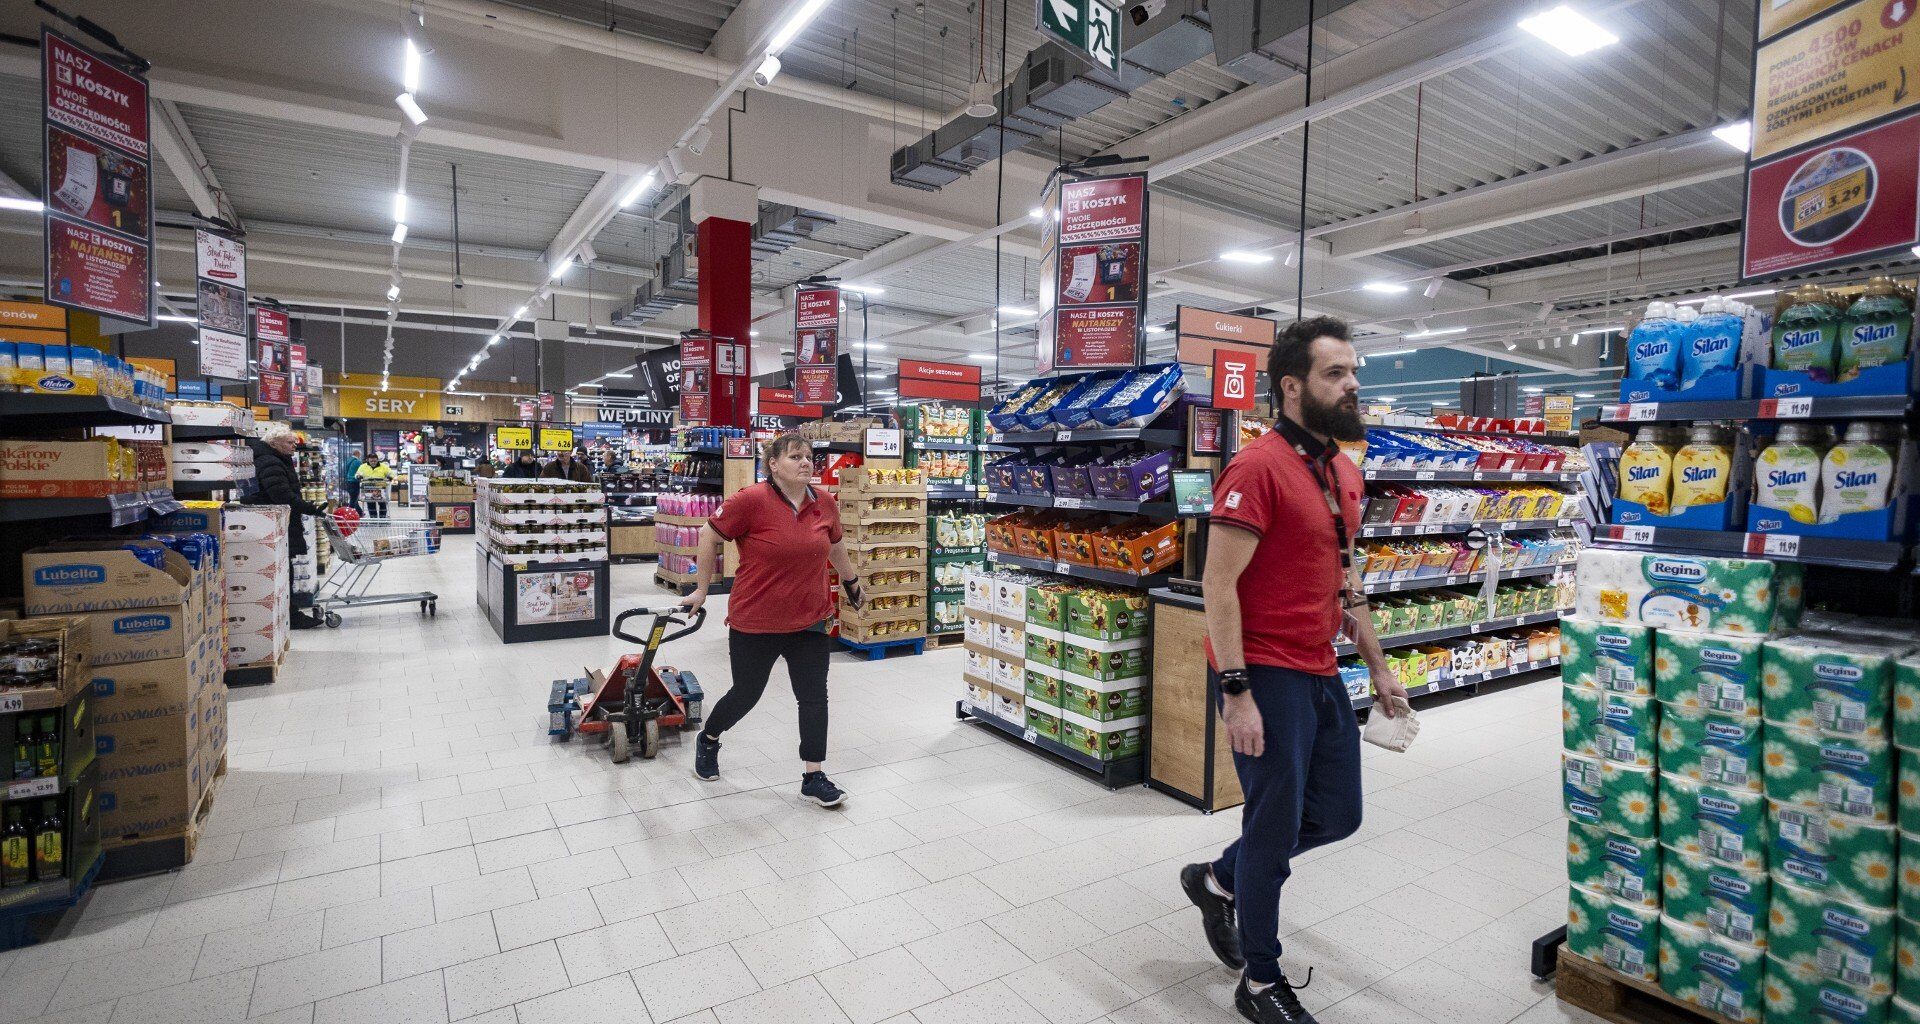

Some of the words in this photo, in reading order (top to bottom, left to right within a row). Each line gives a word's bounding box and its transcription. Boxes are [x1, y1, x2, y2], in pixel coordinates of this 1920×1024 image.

[1770, 52, 1805, 72] PONAD
[1808, 20, 1861, 52] 4500
[1842, 32, 1903, 66] CENACH
[54, 47, 91, 74] NASZ
[56, 86, 88, 105] TWOJE
[76, 74, 129, 107] KOSZYK
[1767, 70, 1846, 108] REGULARNYCH
[1766, 85, 1847, 120] OZNACZONYCH
[1815, 81, 1886, 114] ETYKIETAMI
[56, 97, 130, 133] OSZCZĘDNOŚCI!
[1068, 187, 1095, 199] NASZ
[1828, 186, 1860, 208] 3.29
[1082, 195, 1126, 210] KOSZYK
[1798, 200, 1825, 220] CENY
[113, 211, 121, 227] 1
[1067, 214, 1090, 224] TWOJE
[1067, 217, 1126, 231] OSZCZĘDNOŚCI!
[67, 228, 89, 240] NASZ
[102, 239, 133, 254] KOSZYK
[70, 240, 133, 265] NAJTAŃSZY
[1107, 286, 1115, 300] 1
[808, 300, 830, 308] KOSZYK
[1072, 318, 1123, 328] NAJTAŃSZY
[1215, 322, 1242, 333] Cukierki
[1782, 330, 1820, 350] Silan
[1852, 324, 1895, 346] Silan
[1636, 343, 1668, 360] Silan
[1692, 338, 1728, 356] Silan
[1630, 392, 1648, 401] Silan
[1775, 384, 1799, 396] Silan
[366, 399, 416, 413] SERY
[1791, 404, 1809, 414] 11.99
[599, 409, 672, 424] WĘDLINY
[1641, 409, 1656, 418] 11.99
[132, 425, 154, 434] 1.79
[1628, 466, 1659, 481] Silan
[1682, 467, 1716, 483] Silan
[1767, 470, 1806, 488] Silan
[1834, 471, 1876, 489] Silan
[1621, 512, 1640, 522] Silan
[1758, 521, 1780, 530] Silan
[1635, 532, 1649, 541] 11.99
[1780, 542, 1796, 553] 11.99
[41, 569, 98, 580] Lubella
[1655, 563, 1700, 575] Regina
[119, 618, 165, 629] Lubella
[1599, 635, 1627, 645] Regina
[1704, 650, 1737, 661] Regina
[1818, 665, 1857, 676] Regina
[4, 701, 21, 709] 4.99
[1709, 724, 1741, 735] Regina
[1825, 750, 1864, 760] Regina
[1572, 805, 1598, 817] Regina
[1702, 798, 1736, 811] Regina
[1608, 841, 1637, 854] Regina
[1787, 862, 1822, 880] Regina
[1713, 875, 1746, 890] Regina
[1611, 915, 1639, 928] Regina
[1827, 912, 1864, 931] Regina
[1703, 952, 1736, 967] Regina
[1824, 992, 1862, 1011] Regina
